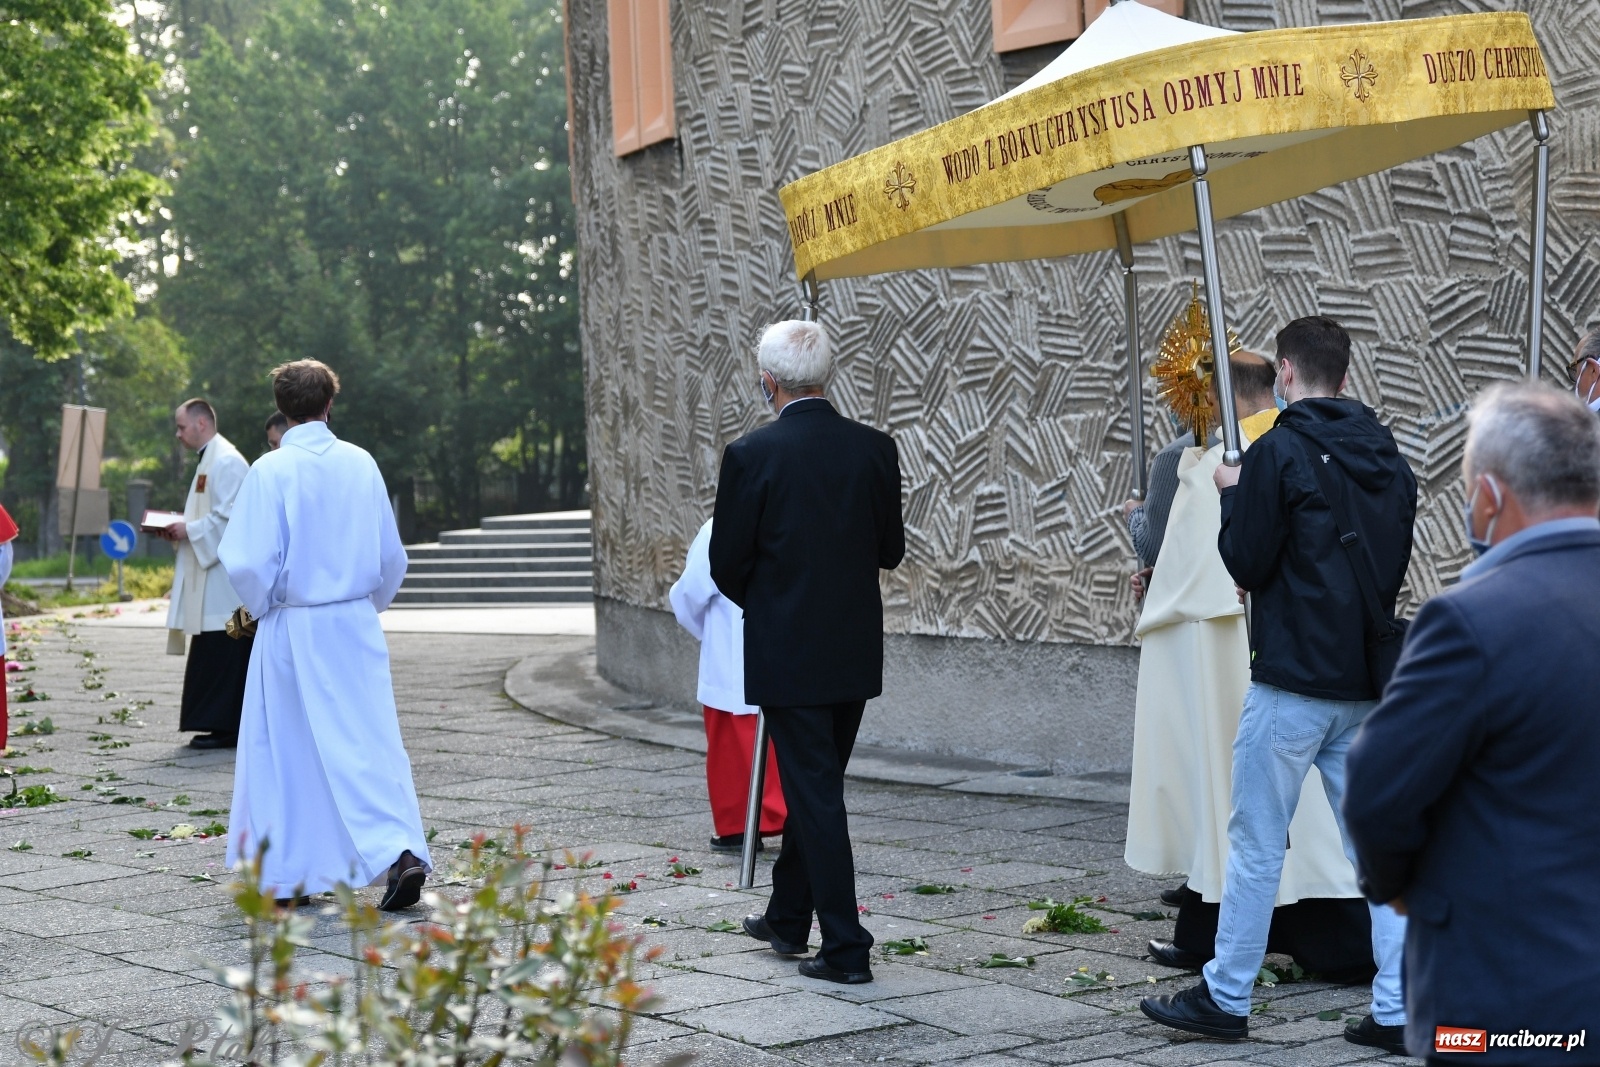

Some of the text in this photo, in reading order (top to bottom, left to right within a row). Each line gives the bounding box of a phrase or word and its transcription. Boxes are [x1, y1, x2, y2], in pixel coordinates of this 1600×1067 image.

[1423, 48, 1476, 84] DUSZO
[942, 63, 1305, 186] WODO Z BOKU CHRYSTUSA OBMYJ MNIE
[824, 193, 858, 233] MNIE
